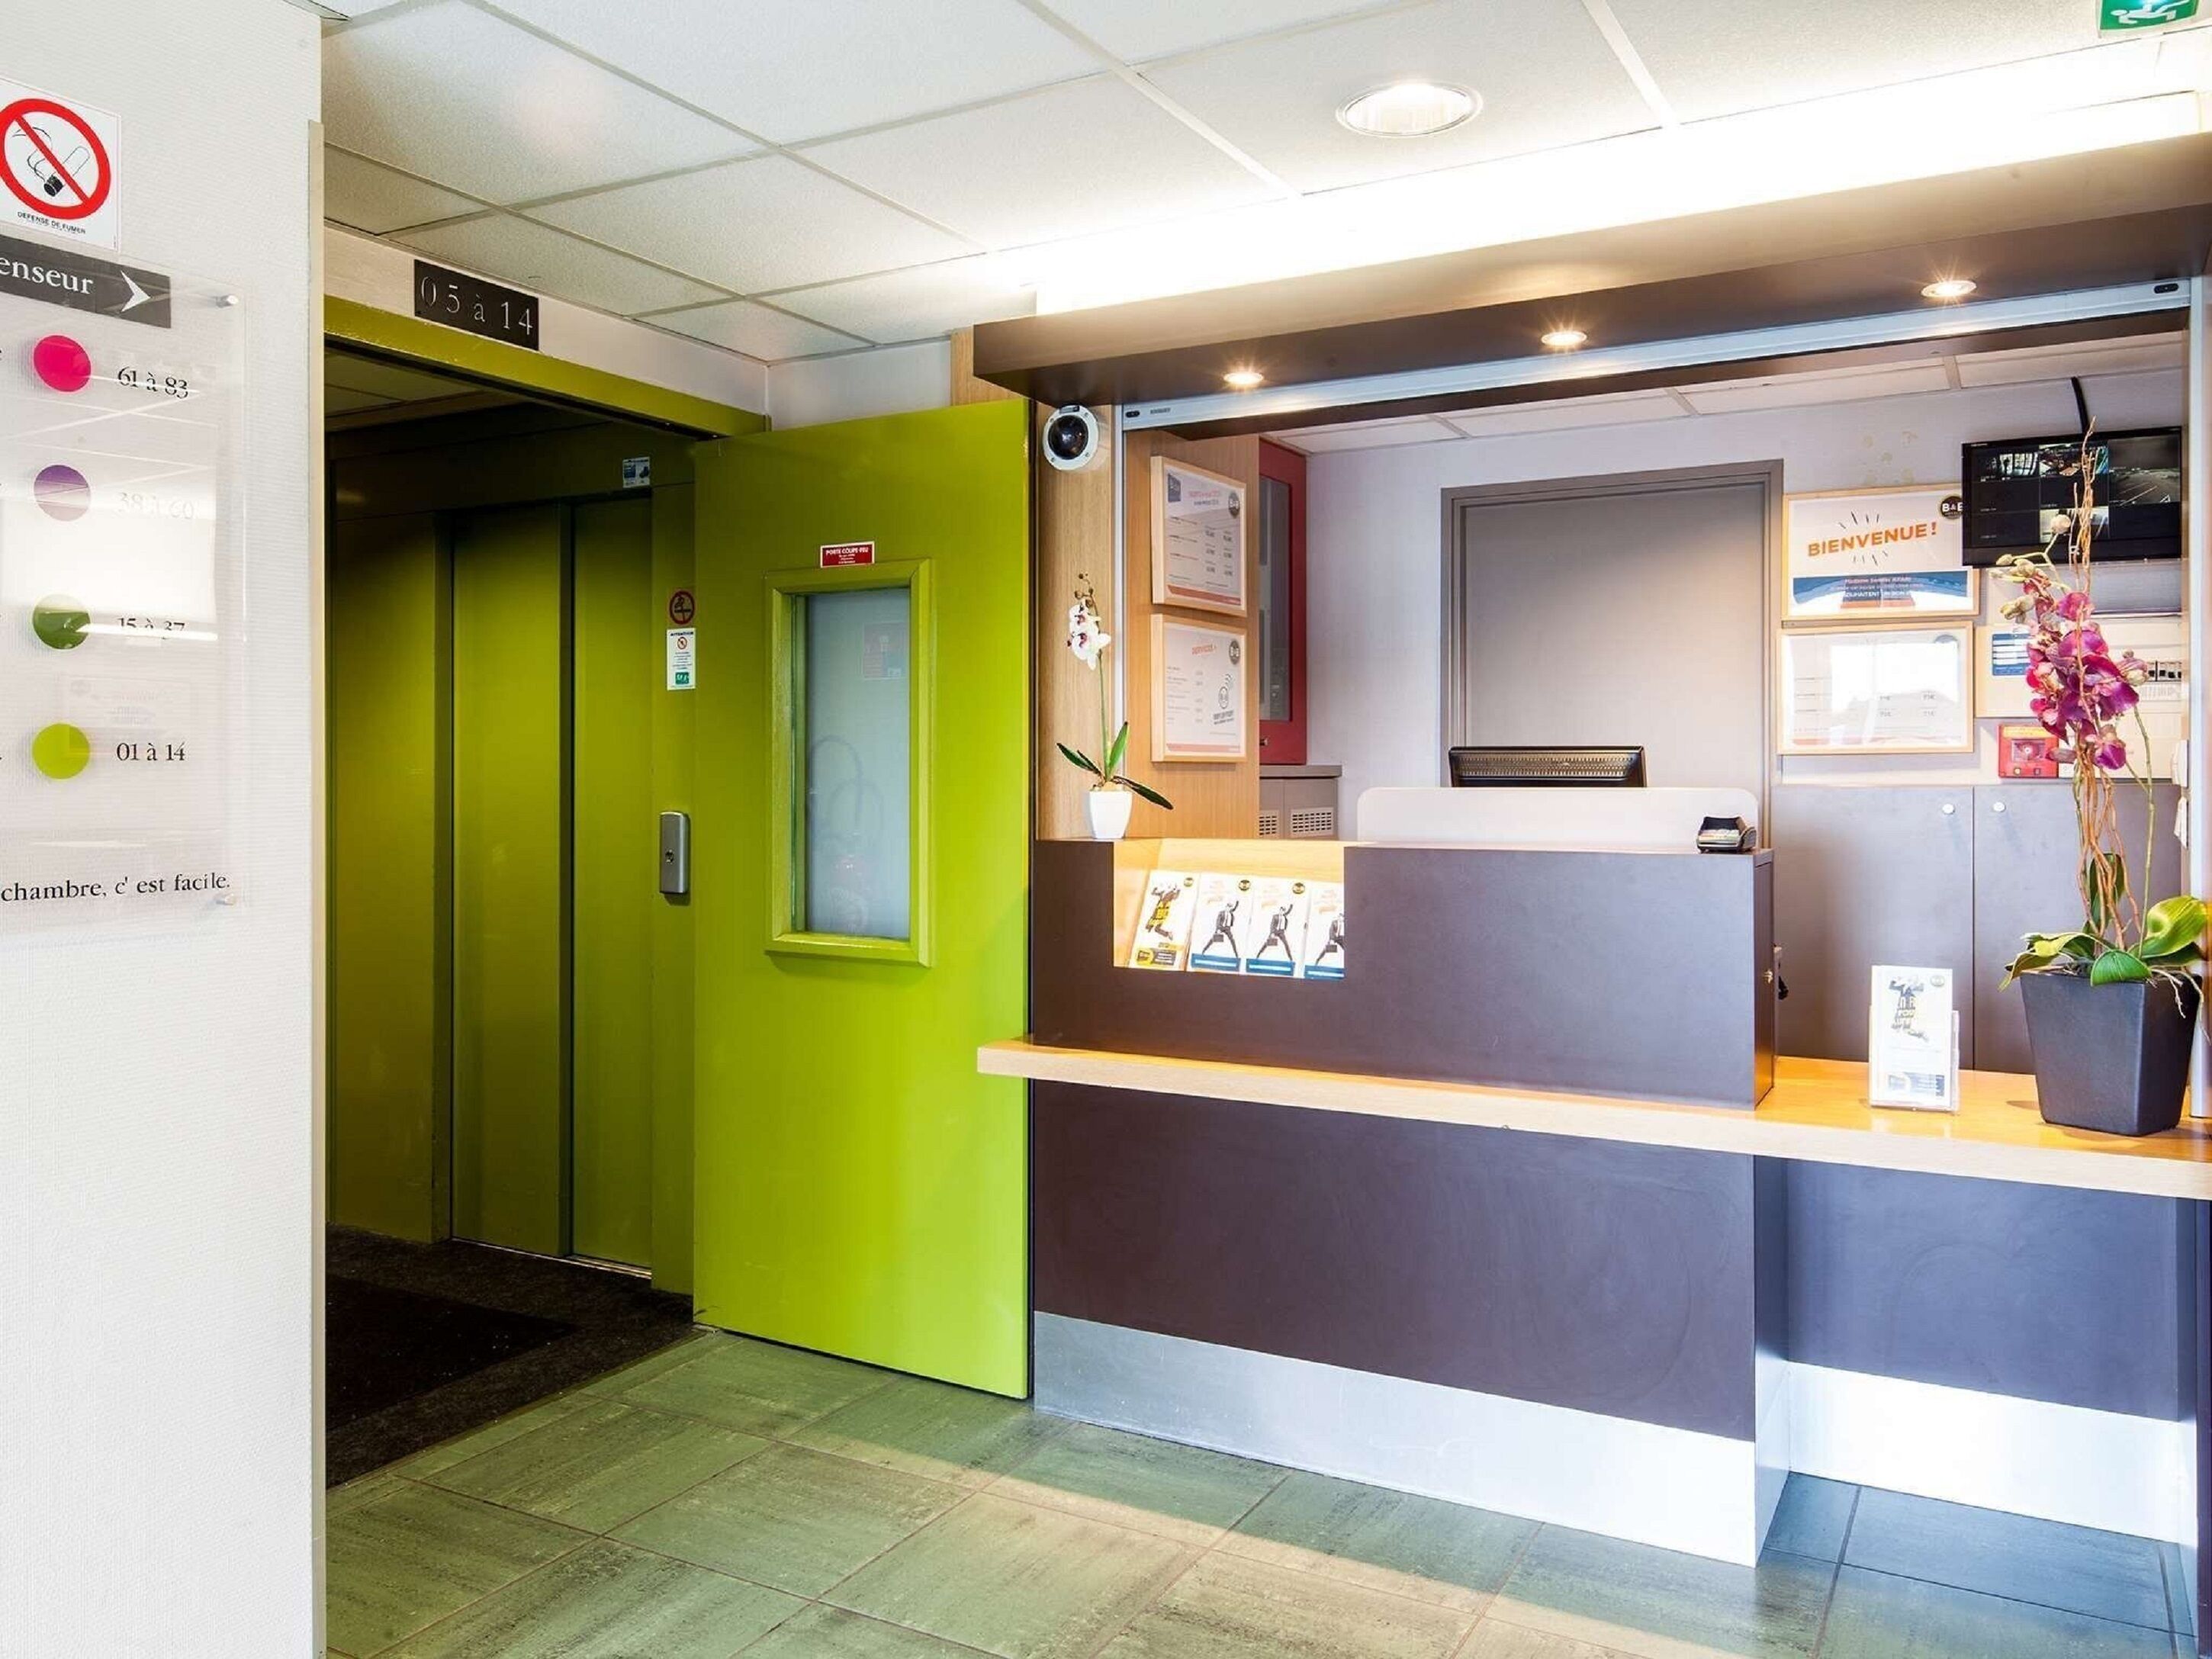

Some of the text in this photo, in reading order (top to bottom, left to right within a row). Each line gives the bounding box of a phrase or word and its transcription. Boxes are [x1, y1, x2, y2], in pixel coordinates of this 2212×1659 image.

[18, 211, 50, 226] DEFENSE
[62, 223, 86, 234] FUMER
[0, 257, 94, 294] enseur
[474, 293, 486, 323] à
[500, 301, 533, 336] 14
[117, 366, 189, 399] 61 à 83
[117, 741, 186, 761] 01 à 14
[0, 879, 107, 902] chambre,
[137, 879, 166, 893] est
[174, 872, 230, 891] facile.
